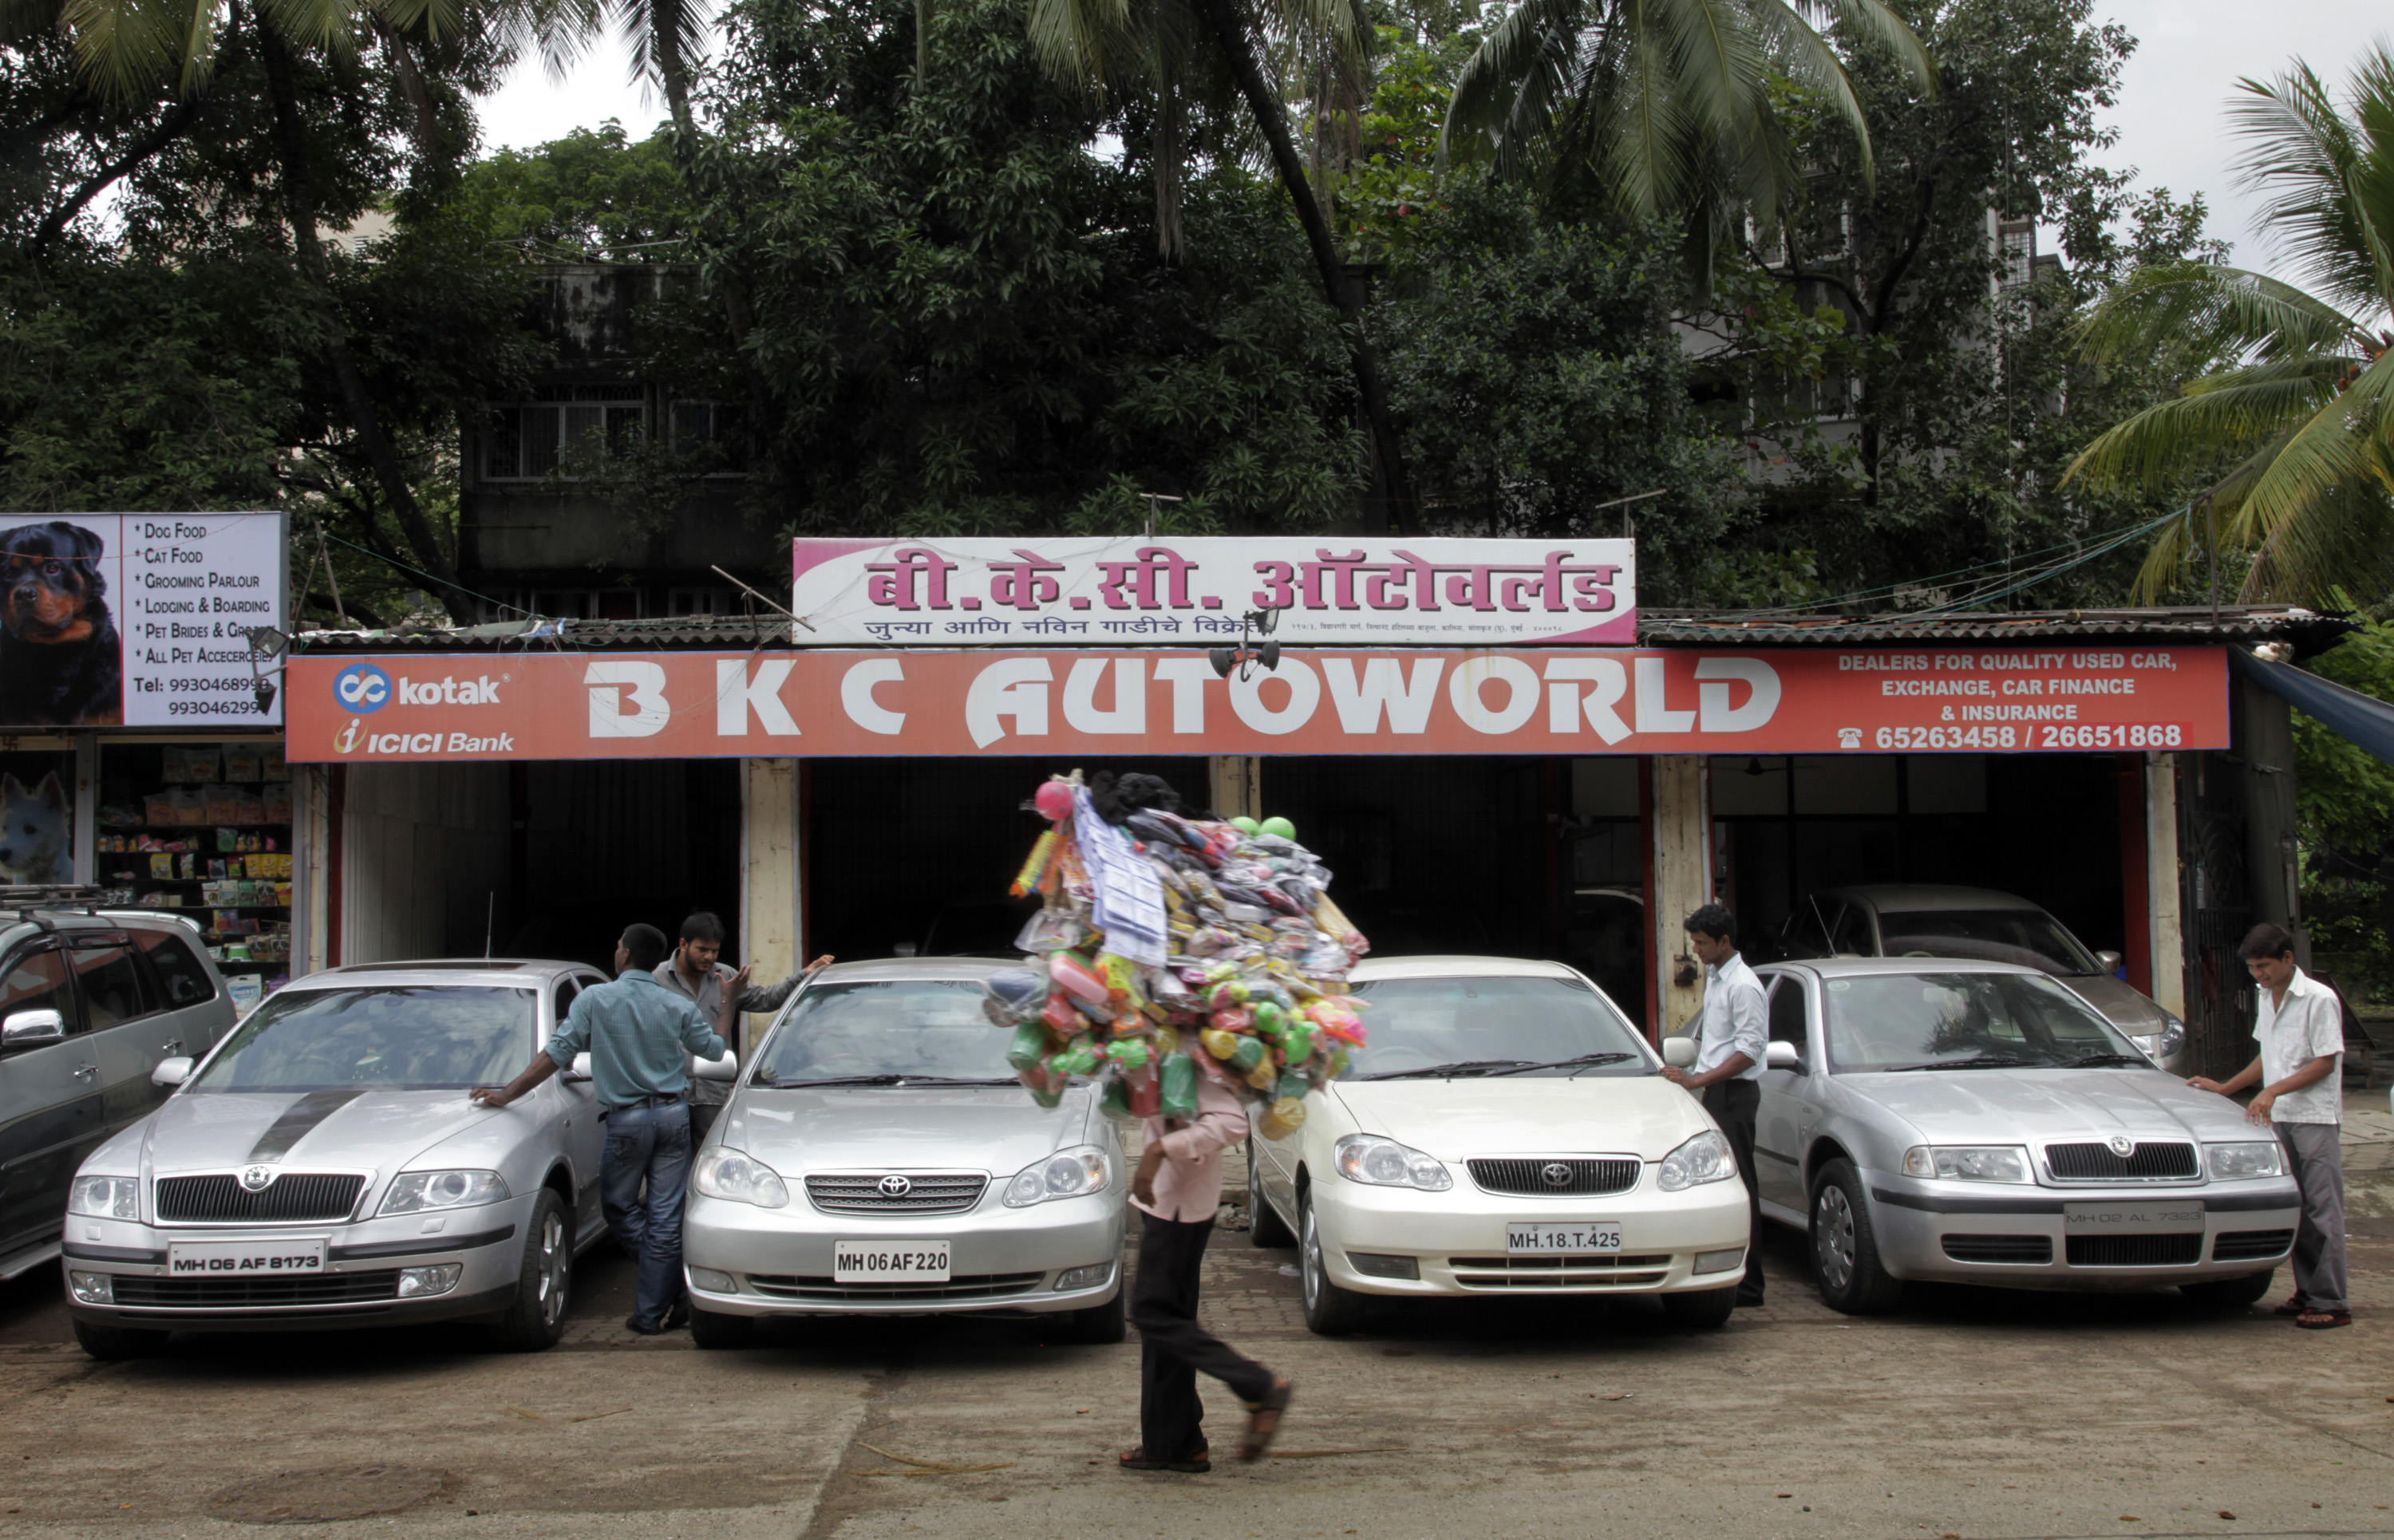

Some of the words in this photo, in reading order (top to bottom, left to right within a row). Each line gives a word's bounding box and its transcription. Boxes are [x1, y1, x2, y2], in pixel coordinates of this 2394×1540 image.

[199, 597, 209, 613] &
[212, 622, 223, 638] &
[863, 622, 933, 640] जुन्या
[944, 616, 1011, 634] आणि
[1021, 616, 1089, 634] नविन
[1100, 616, 1183, 634] गाडीचे
[1839, 655, 1929, 671] DEALERS
[1935, 655, 1975, 670] FOR
[1980, 654, 2066, 672] QUALITY
[2072, 654, 2126, 669] USED
[2131, 653, 2177, 672] CAR,
[134, 678, 164, 693] Tel:
[399, 675, 501, 705] kotak
[1882, 680, 1997, 699] EXCHANGE,
[2002, 680, 2044, 695] CAR
[2048, 678, 2135, 695] FINANCE
[169, 701, 260, 715] 993046299
[965, 656, 1782, 750] AUTOWORLD
[1941, 705, 1956, 721] &
[1961, 704, 2078, 721] INSURANCE
[367, 733, 443, 753] ICICI
[447, 732, 516, 752] Bank
[1875, 726, 2017, 749] 65263458
[2041, 725, 2183, 748] 26651868
[2066, 1214, 2095, 1222] MH
[2099, 1214, 2122, 1222] 02
[2128, 1213, 2151, 1222] AL
[2158, 1212, 2201, 1221] 7323
[174, 1259, 205, 1271] MH
[209, 1258, 235, 1270] 06
[239, 1257, 267, 1270] AF
[270, 1256, 319, 1268] 8173
[838, 1254, 864, 1270] MH
[915, 1252, 948, 1270] 220
